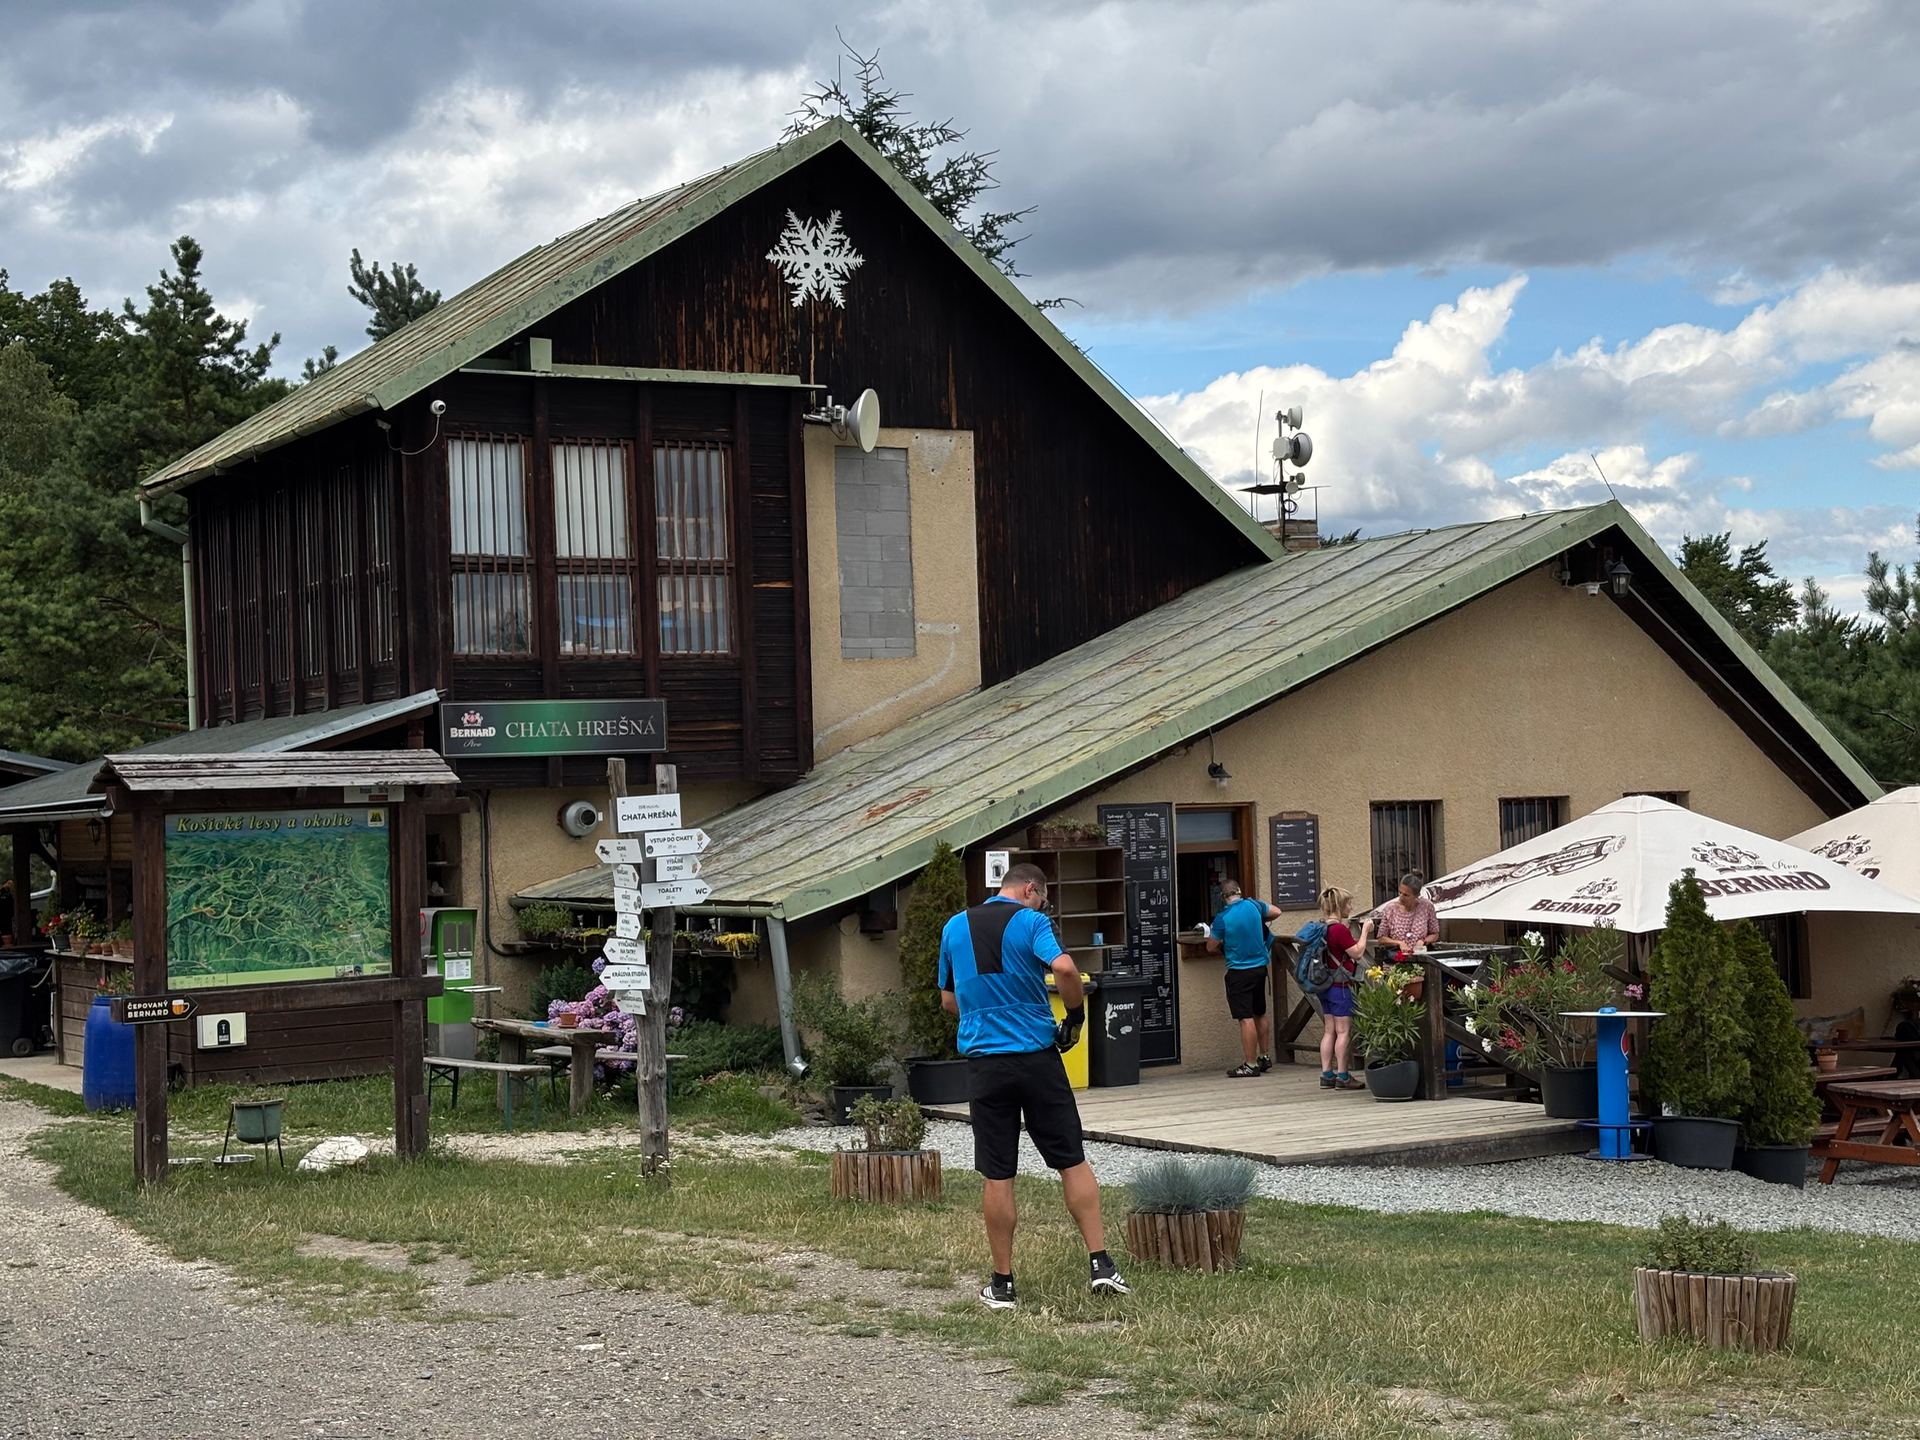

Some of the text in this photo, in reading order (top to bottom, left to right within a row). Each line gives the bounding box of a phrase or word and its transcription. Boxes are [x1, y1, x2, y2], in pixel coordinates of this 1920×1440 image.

[450, 727, 497, 738] BERNARD
[505, 716, 657, 738] CHATA HREŠNÁ
[621, 809, 678, 821] CHATA HREŠNÁ
[176, 813, 353, 832] Košické lesy a okolie
[1772, 860, 1799, 870] Pivo
[1696, 870, 1831, 899] BERNARD
[1528, 899, 1622, 916] BERNARD
[127, 1000, 169, 1010] ČEPOVANÝ
[127, 1010, 169, 1018] BERNARD
